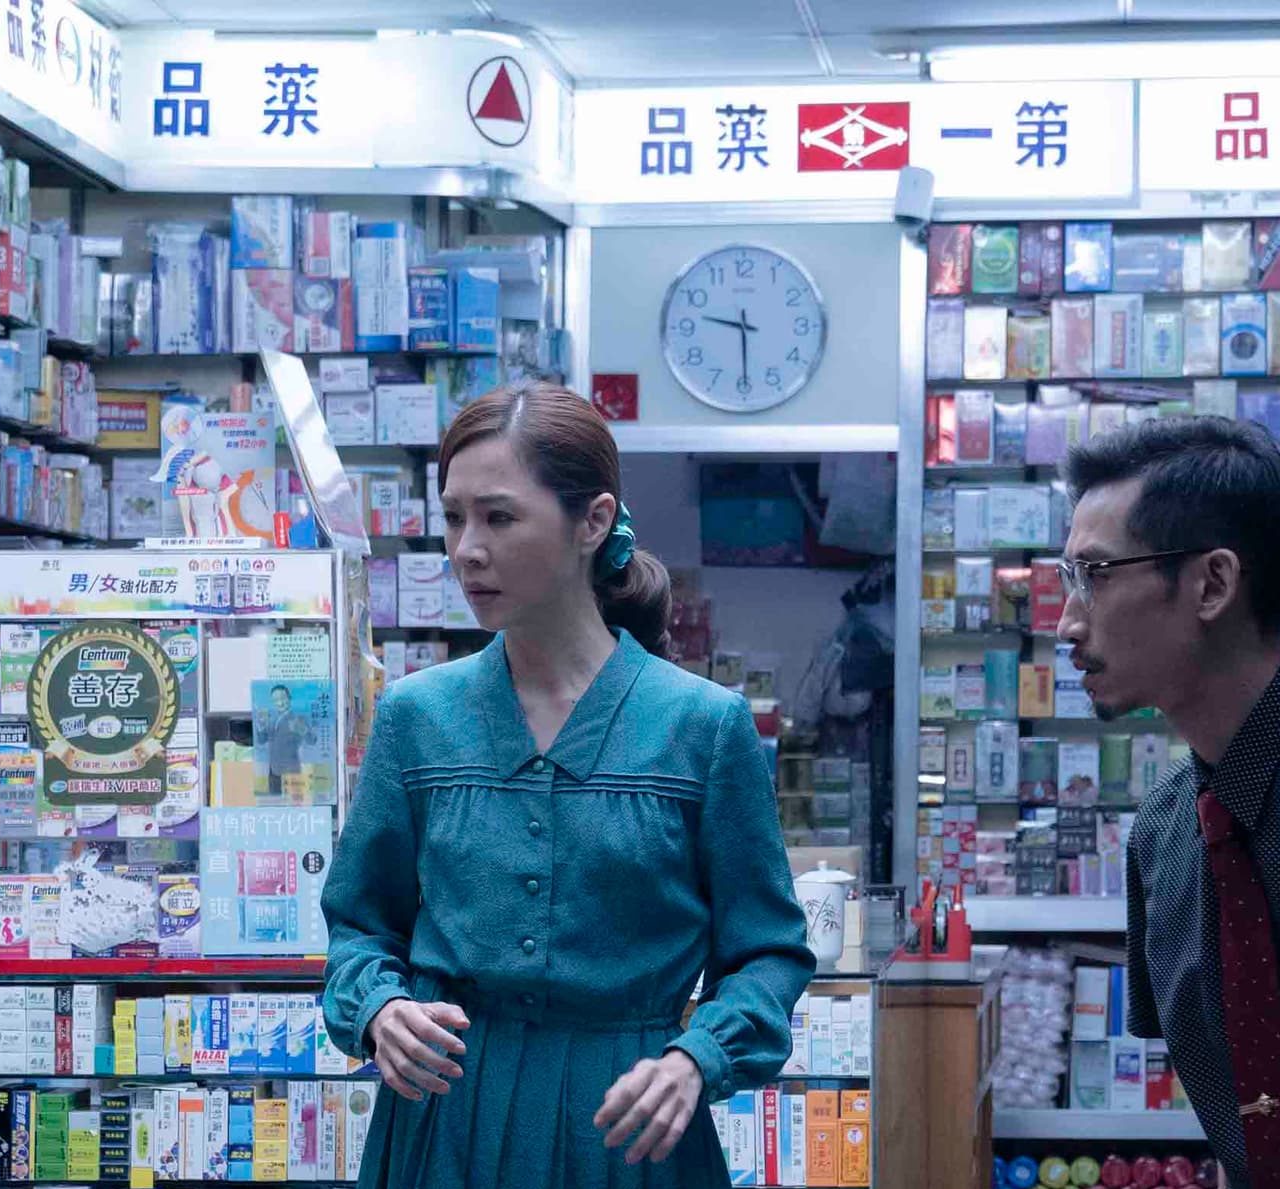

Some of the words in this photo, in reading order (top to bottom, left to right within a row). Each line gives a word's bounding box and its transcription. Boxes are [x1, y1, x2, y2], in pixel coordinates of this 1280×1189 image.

[710, 267, 724, 285] 11
[735, 260, 754, 279] 12
[688, 288, 708, 308] 10
[786, 289, 801, 307] 2
[679, 318, 695, 337] 9
[794, 317, 809, 337] 3
[688, 347, 703, 365] 8
[786, 346, 799, 361] 4
[709, 369, 723, 386] 7
[765, 368, 780, 386] 5
[80, 649, 128, 661] Centrum
[70, 674, 140, 707] 善存
[193, 1049, 229, 1061] NAZAL
